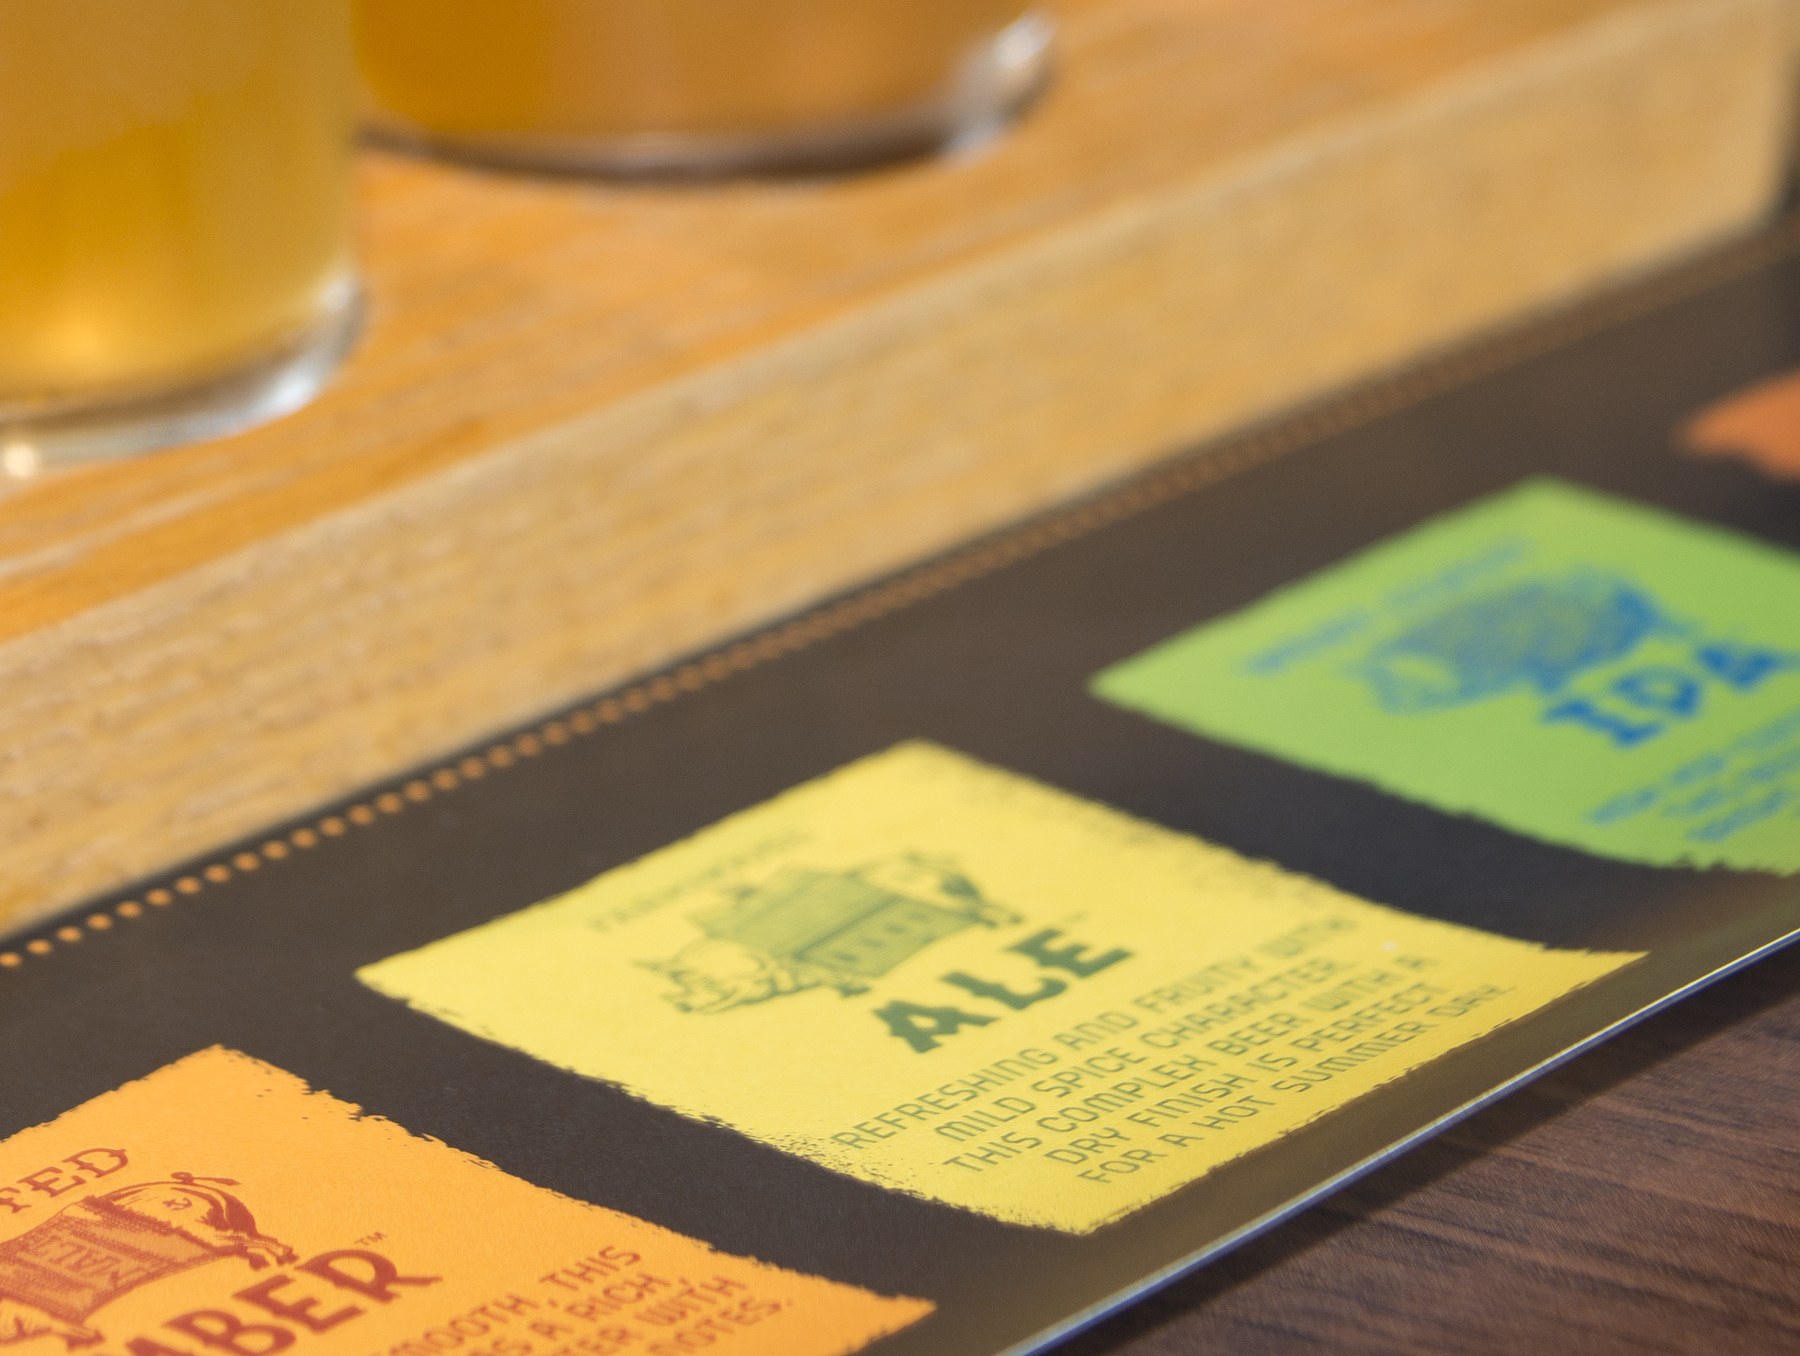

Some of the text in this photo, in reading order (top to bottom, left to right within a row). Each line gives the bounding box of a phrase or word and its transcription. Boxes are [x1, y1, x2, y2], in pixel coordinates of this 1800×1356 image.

[830, 1047, 1059, 1149] REFRESHING
[1052, 1010, 1139, 1050] AND
[1132, 955, 1264, 1015] FRUITY
[872, 927, 1135, 1055] ALE
[934, 1096, 1037, 1143] MILD
[1031, 1046, 1149, 1099] SPICE
[942, 954, 1440, 1172] THIS COMPLEX BEER WITH A
[1043, 981, 1450, 1165] DRY FINISH IS PERFECT
[1077, 1147, 1170, 1183] FOR
[1156, 1131, 1206, 1148] A
[1191, 1094, 1276, 1131] HOT
[1270, 1019, 1440, 1093] SUMMER
[528, 1320, 576, 1342] A
[539, 1245, 642, 1292] THIS
[633, 1274, 749, 1326] WITH
